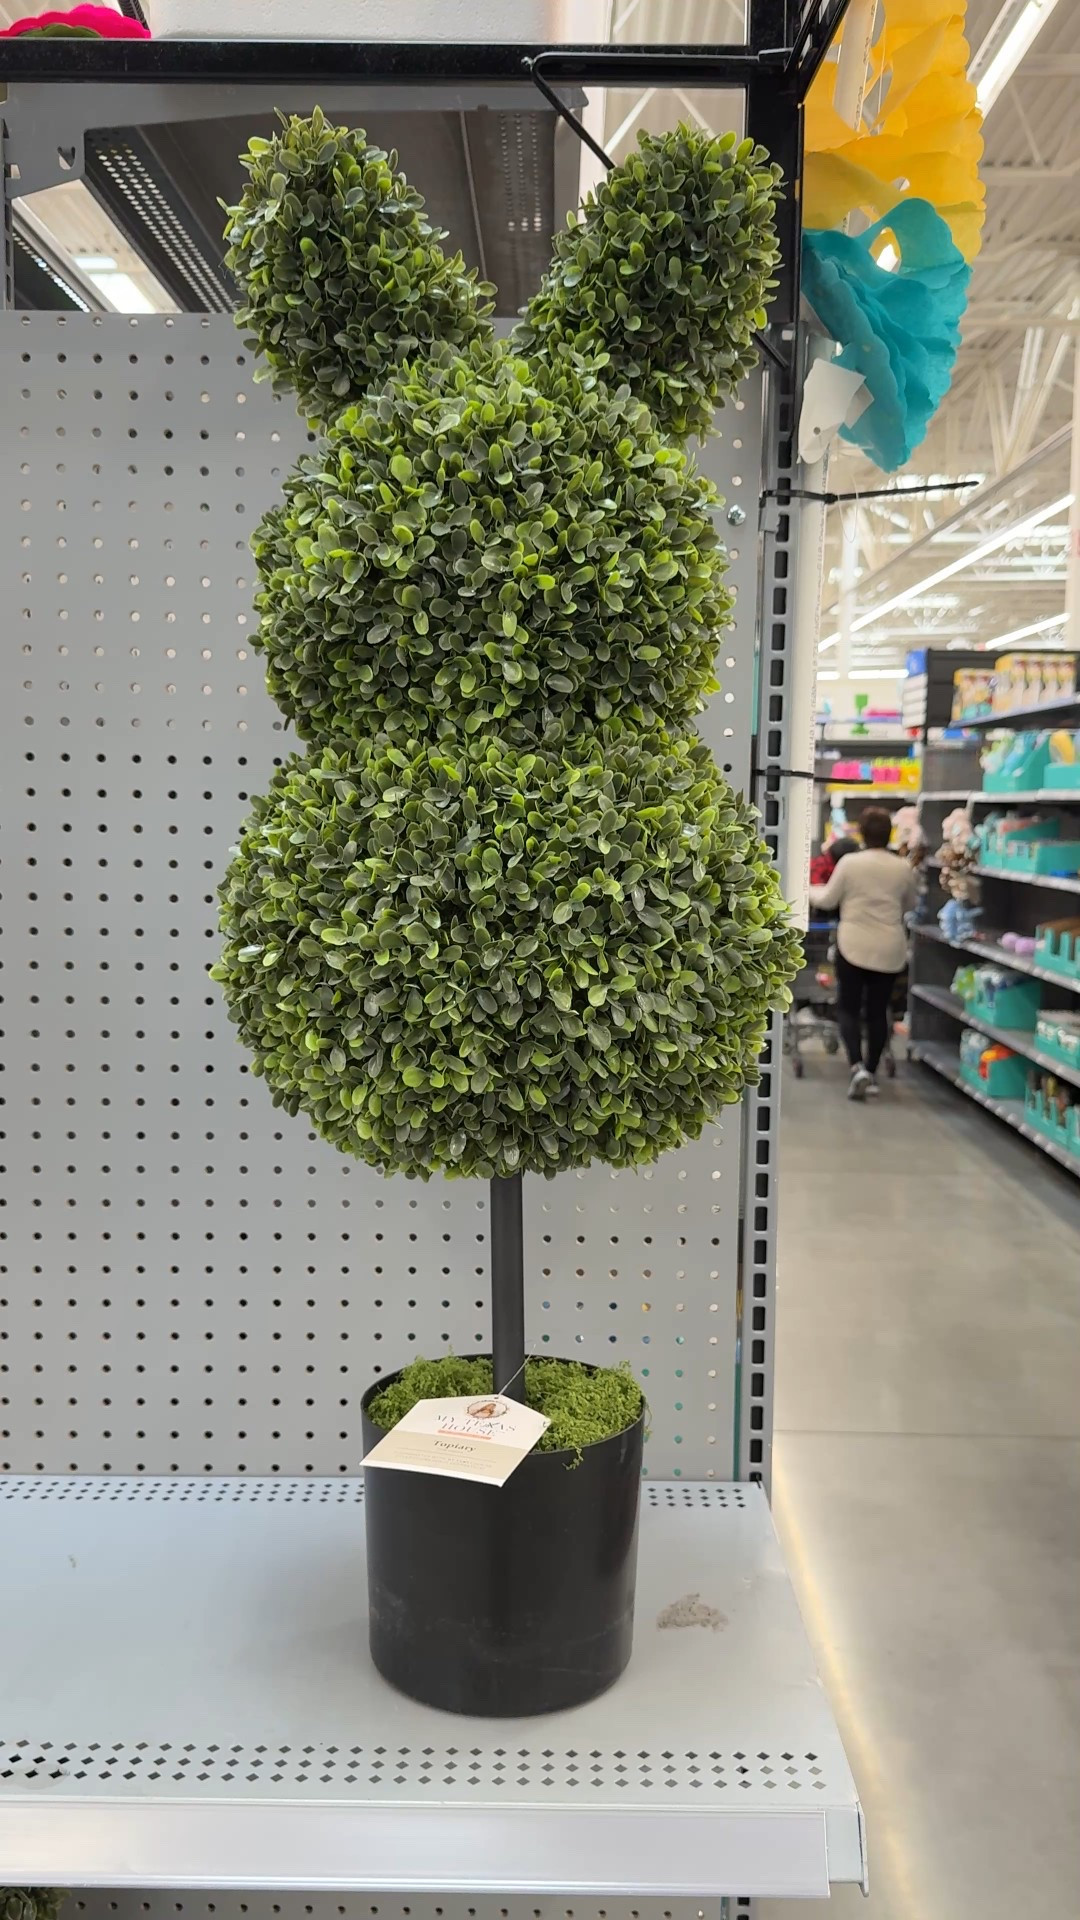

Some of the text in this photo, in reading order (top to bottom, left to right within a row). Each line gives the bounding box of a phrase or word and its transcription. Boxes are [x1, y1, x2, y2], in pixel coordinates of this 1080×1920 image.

[437, 1415, 516, 1431] MY TEXAS
[441, 1423, 496, 1436] HOUSE
[434, 1440, 477, 1453] Topiary
